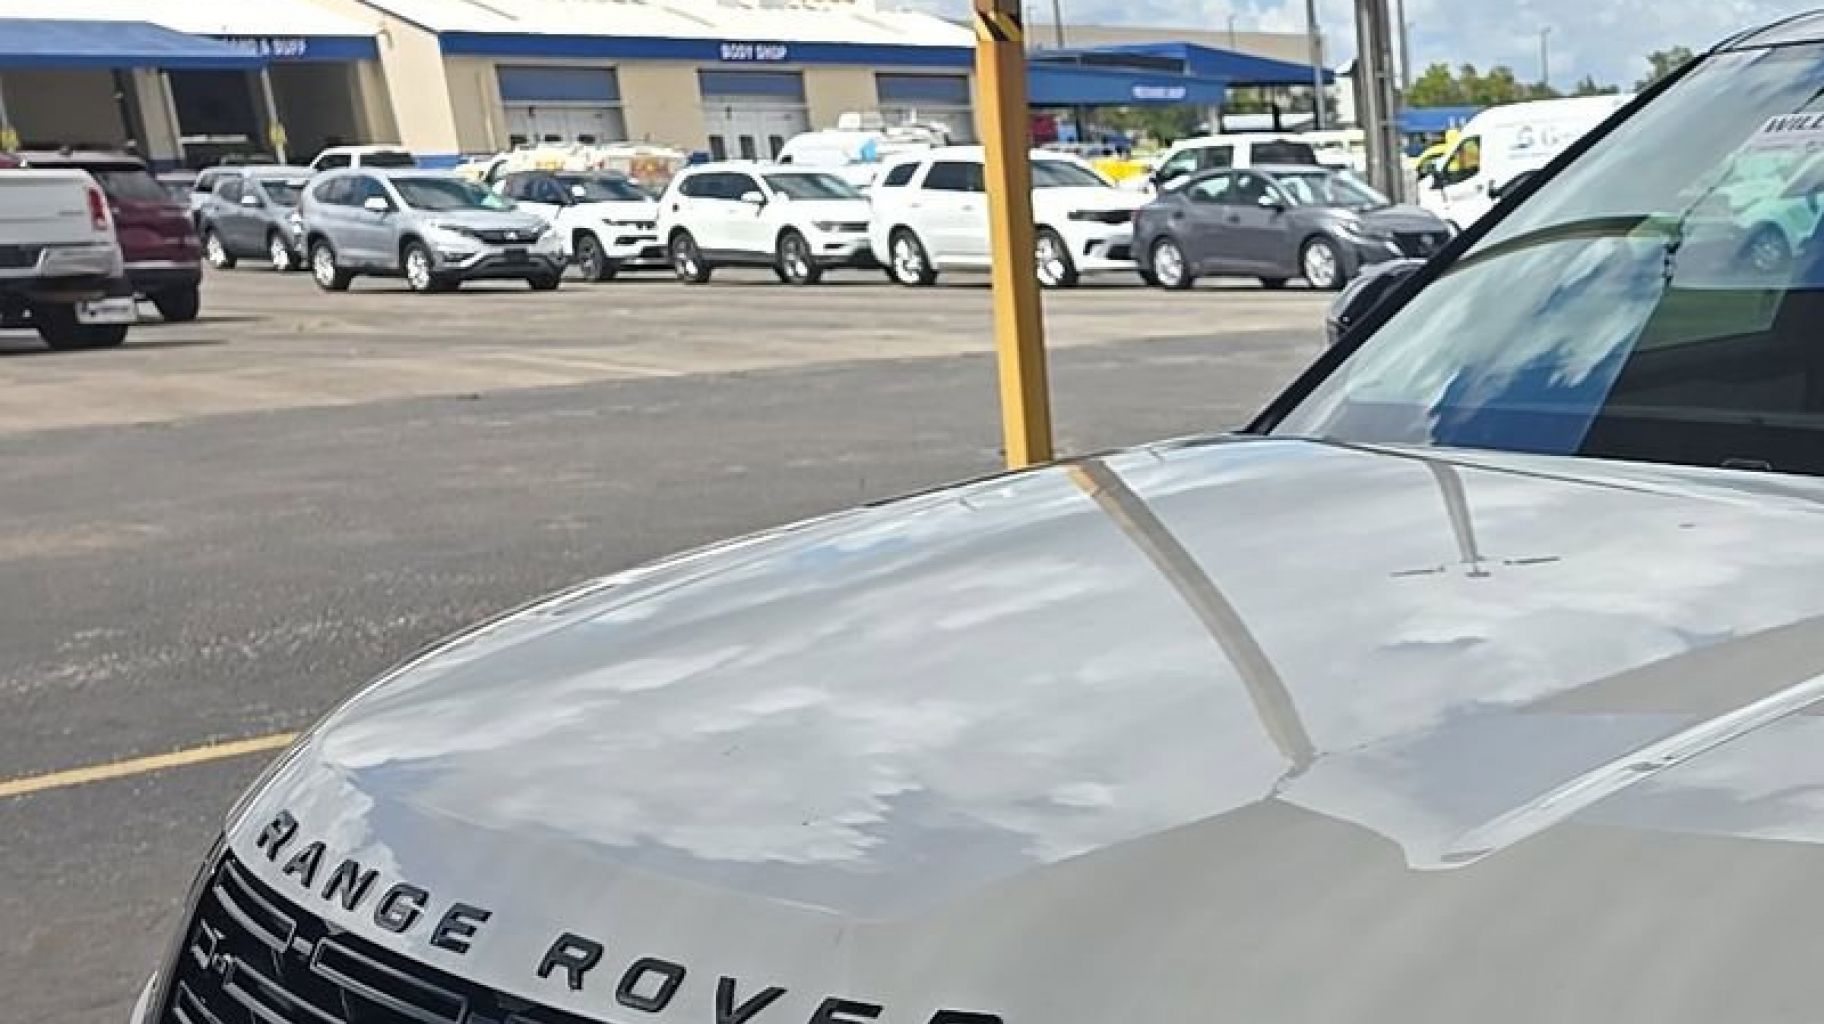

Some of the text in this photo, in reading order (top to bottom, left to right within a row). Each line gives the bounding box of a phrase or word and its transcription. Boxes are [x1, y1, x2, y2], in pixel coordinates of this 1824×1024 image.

[722, 42, 788, 61] BODY SHOP
[256, 808, 494, 955] RANGE
